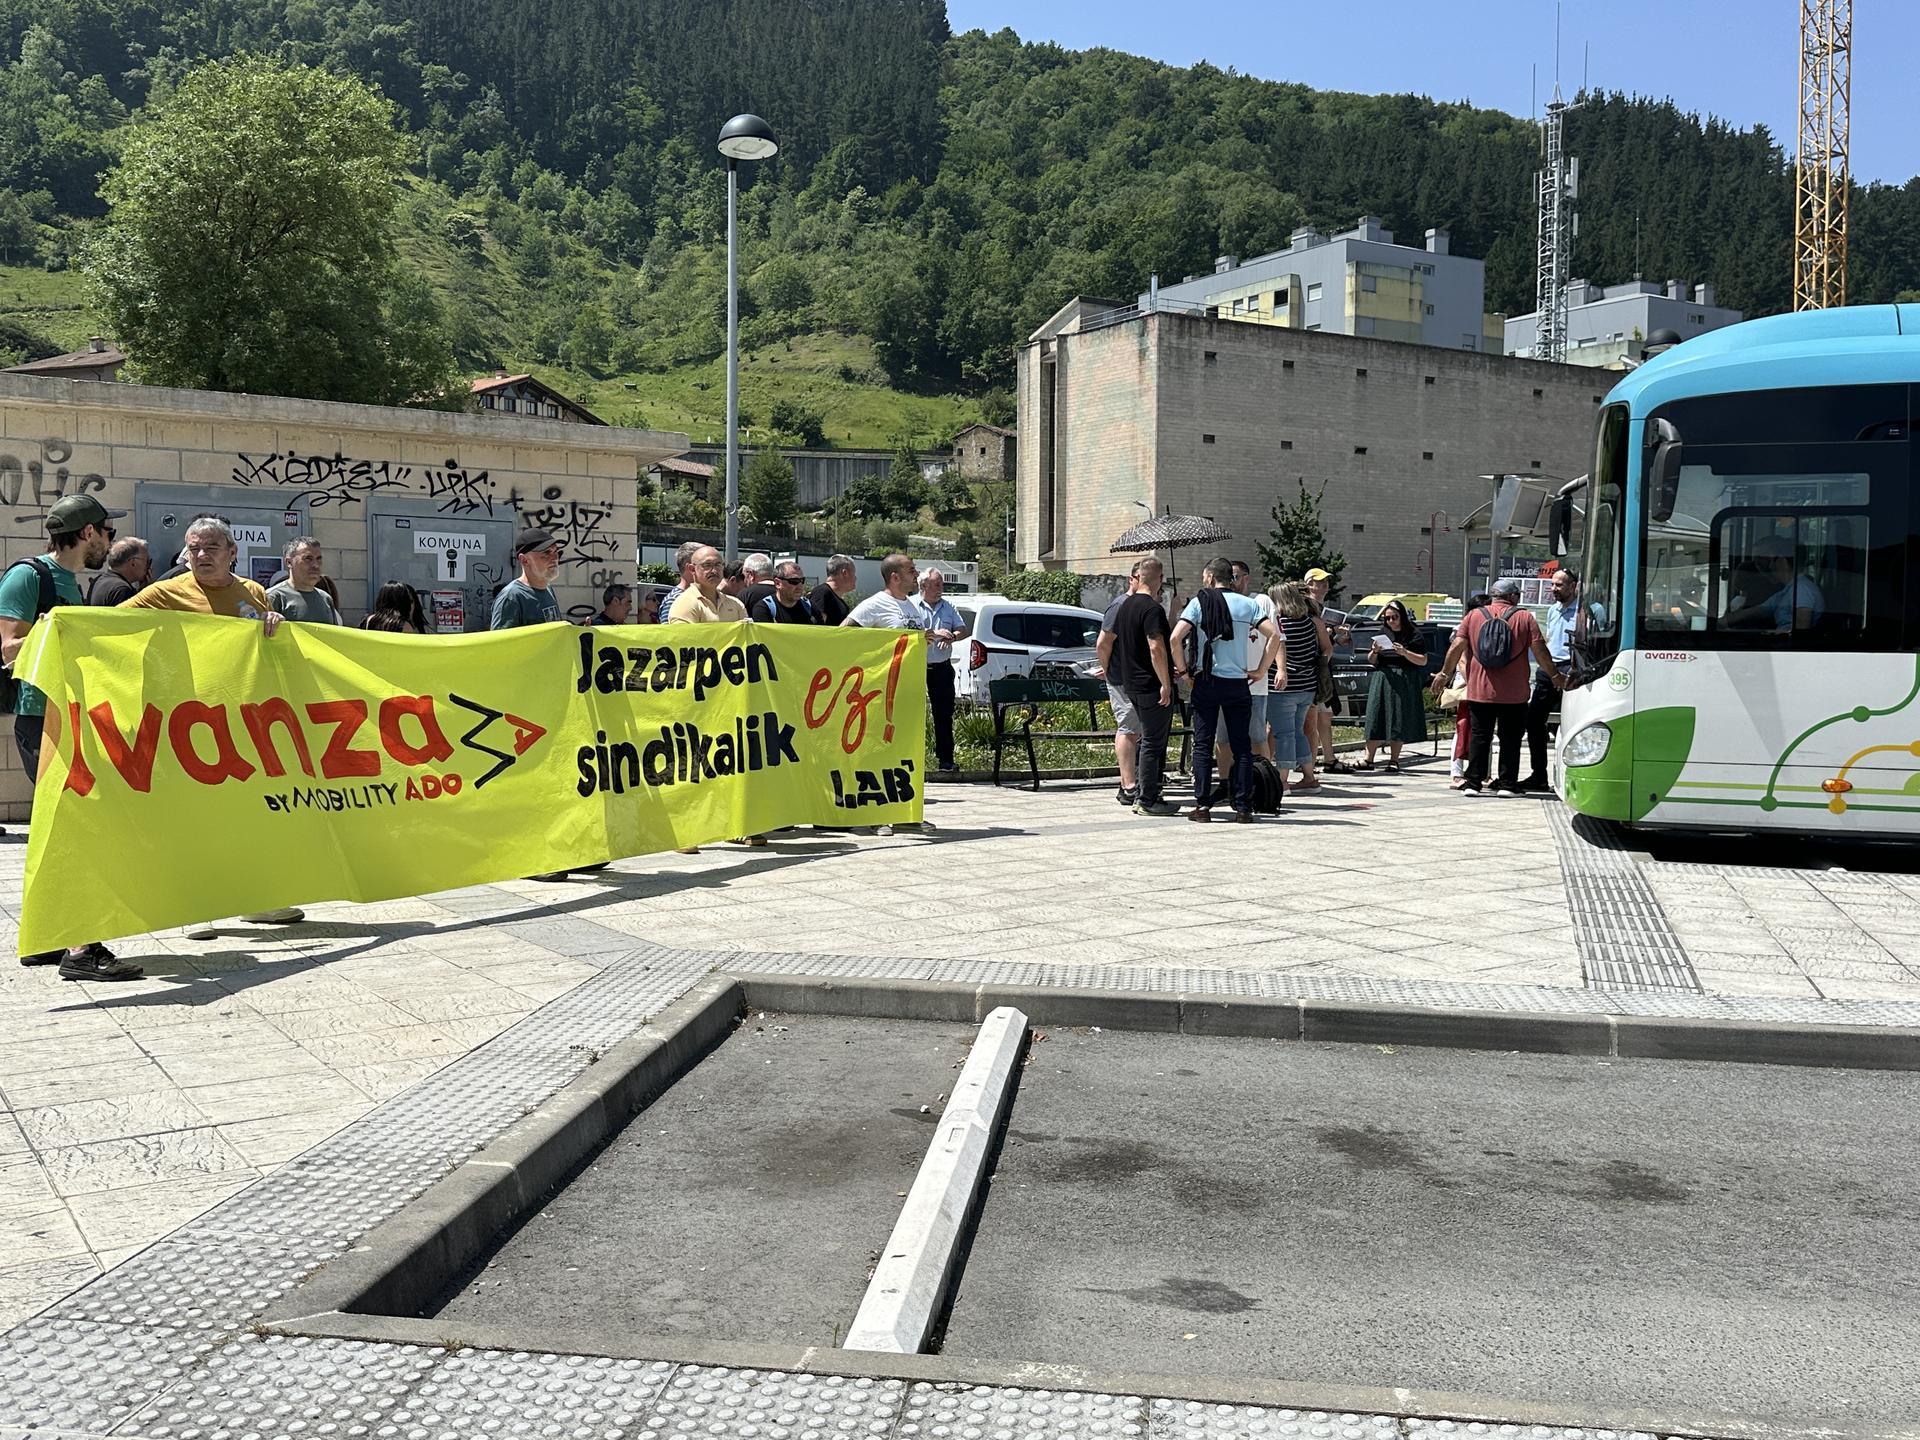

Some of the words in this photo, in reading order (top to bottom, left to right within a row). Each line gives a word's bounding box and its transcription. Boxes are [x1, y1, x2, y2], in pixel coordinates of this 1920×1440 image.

[233, 530, 266, 543] UNA
[419, 537, 481, 550] KOMUNA
[577, 632, 778, 701] Jazarpen
[1645, 652, 1687, 660] avanza
[804, 633, 908, 754] ez!
[1610, 673, 1628, 686] 395
[576, 711, 800, 797] sindikalik
[293, 782, 398, 811] MOBILITY
[405, 773, 463, 801] ADO
[830, 760, 914, 809] LAB
